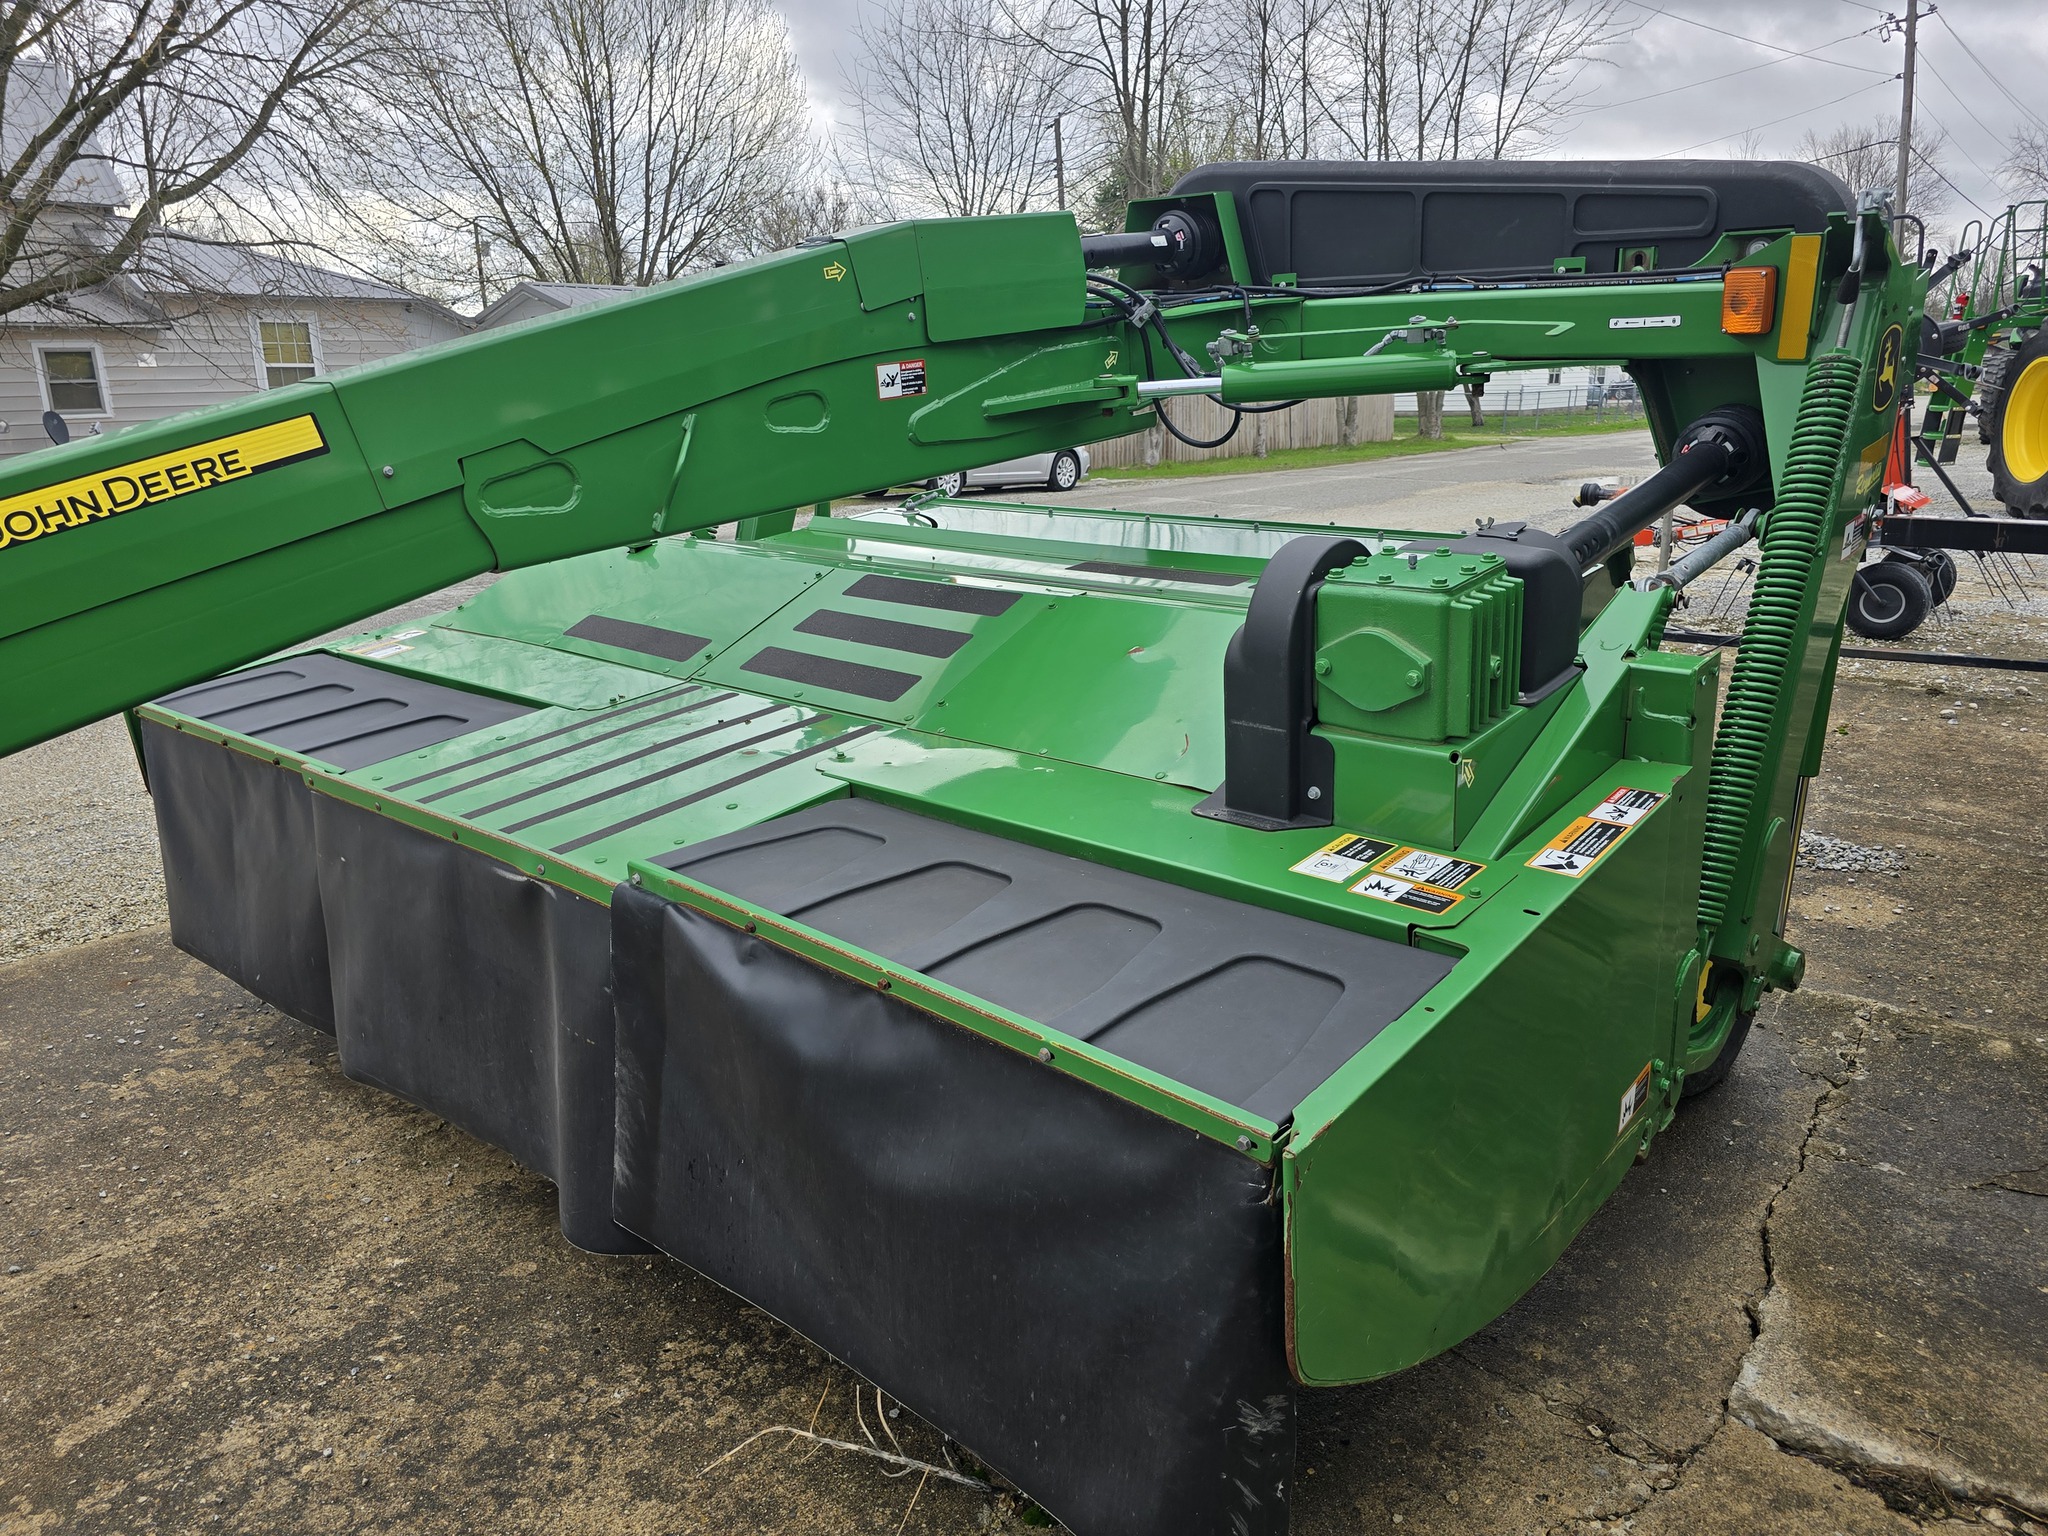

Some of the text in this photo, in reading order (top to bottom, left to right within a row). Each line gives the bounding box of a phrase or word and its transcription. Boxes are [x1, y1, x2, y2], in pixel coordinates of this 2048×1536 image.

[906, 361, 923, 369] DANGER
[0, 449, 248, 543] OHN DEERE
[1564, 825, 1584, 839] WARNING
[1331, 836, 1353, 849] CAUTION
[1385, 850, 1410, 865] WARNING
[1425, 888, 1458, 899] WARNING
